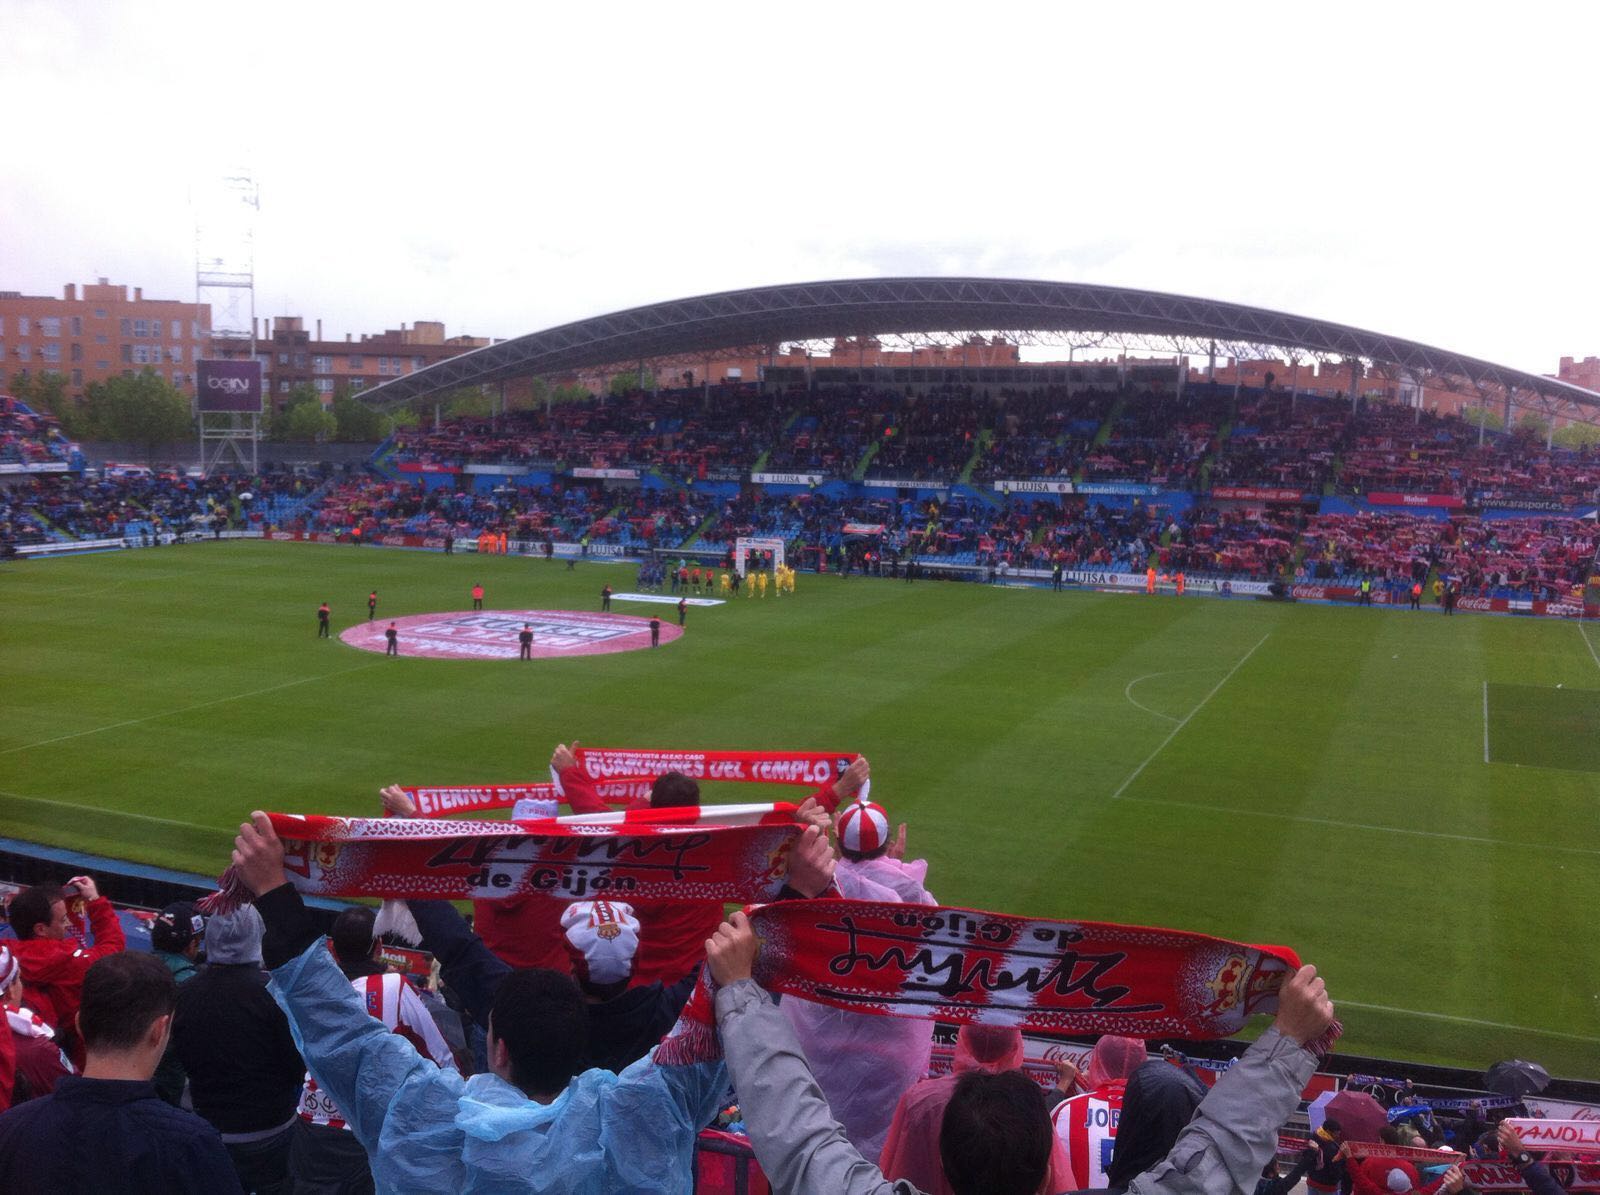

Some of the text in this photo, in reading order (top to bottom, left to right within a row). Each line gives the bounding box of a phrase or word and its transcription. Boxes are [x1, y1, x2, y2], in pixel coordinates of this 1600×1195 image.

[771, 474, 800, 483] LUJISA
[1016, 482, 1049, 492] LUJISA
[752, 760, 831, 783] TEMPLO
[466, 868, 637, 896] de Gijón
[1033, 926, 1084, 952] de
